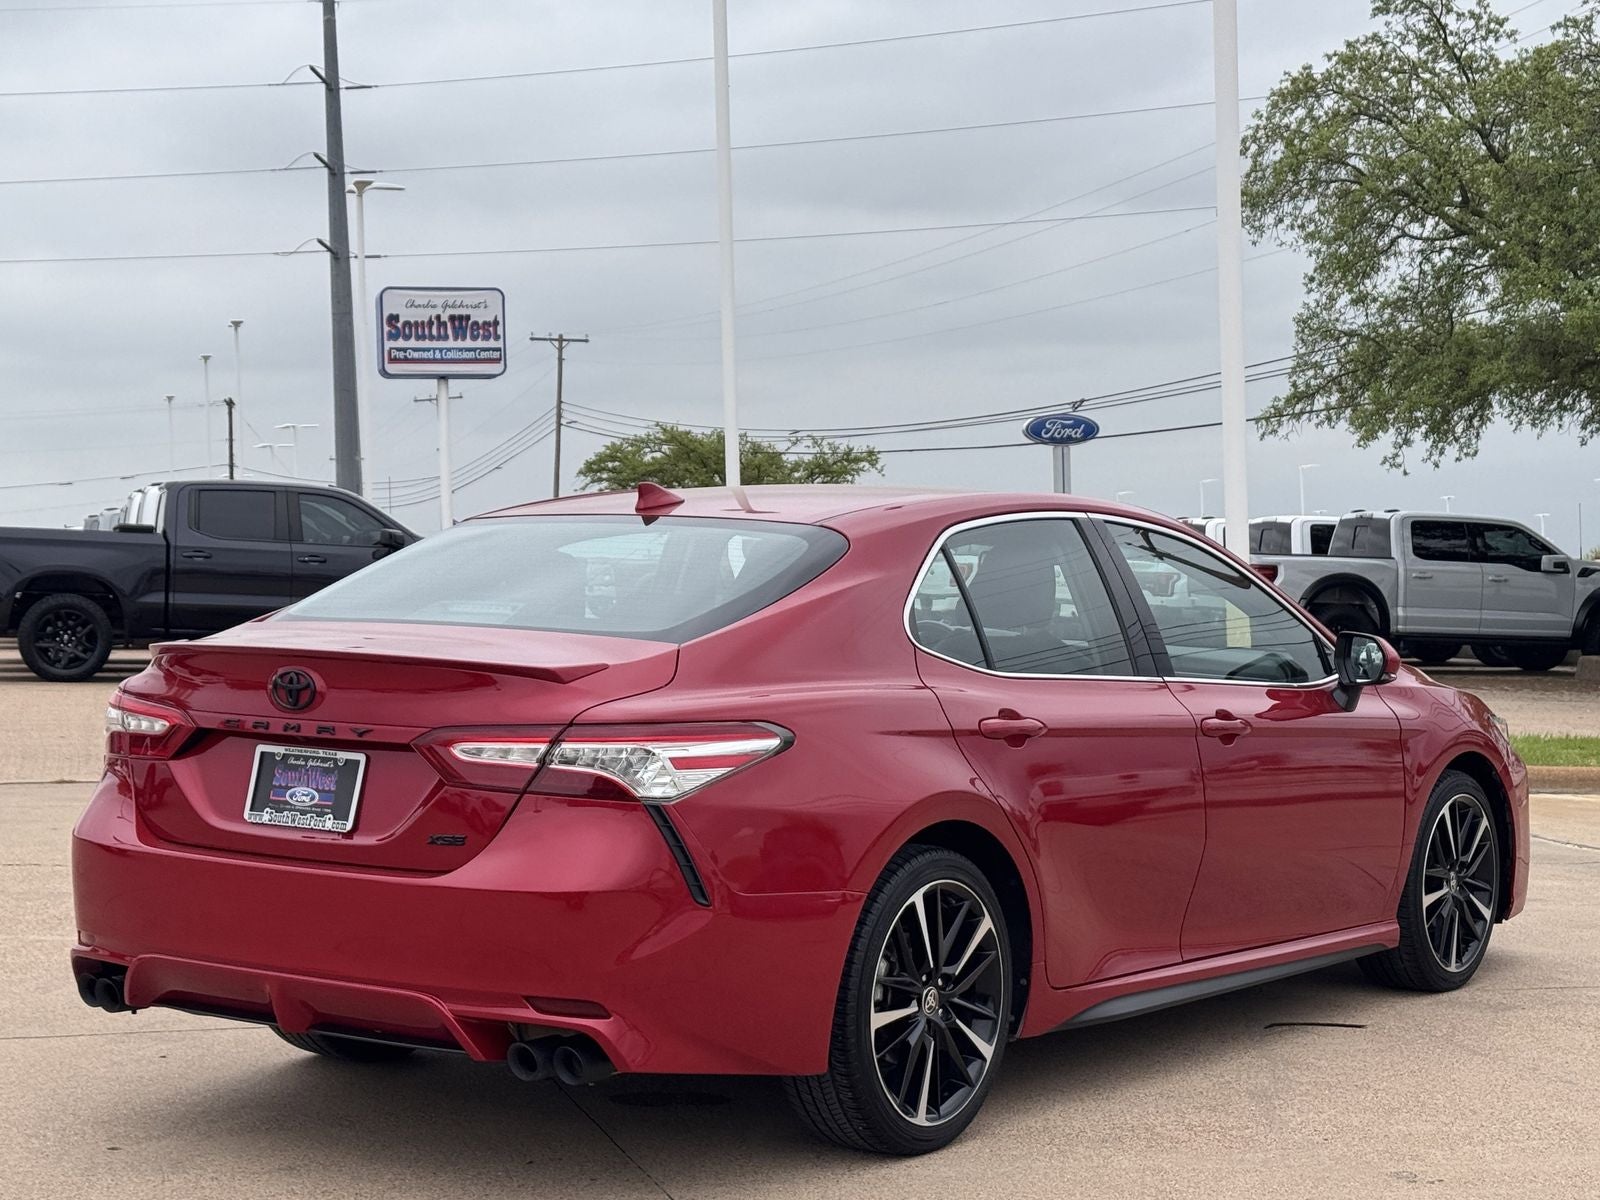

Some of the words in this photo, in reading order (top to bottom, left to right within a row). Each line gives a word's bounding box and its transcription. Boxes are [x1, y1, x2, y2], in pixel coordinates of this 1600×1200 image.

[405, 298, 437, 309] Charlie
[441, 299, 488, 313] Gilchrist's
[385, 313, 501, 341] SouthWest
[391, 349, 433, 359] Pre-Owned
[434, 349, 441, 359] &
[442, 349, 474, 359] Collision
[476, 349, 501, 359] Center
[1041, 419, 1085, 438] Ford
[222, 718, 374, 738] CAMRY
[292, 790, 312, 802] Ford
[427, 834, 468, 847] XSE
